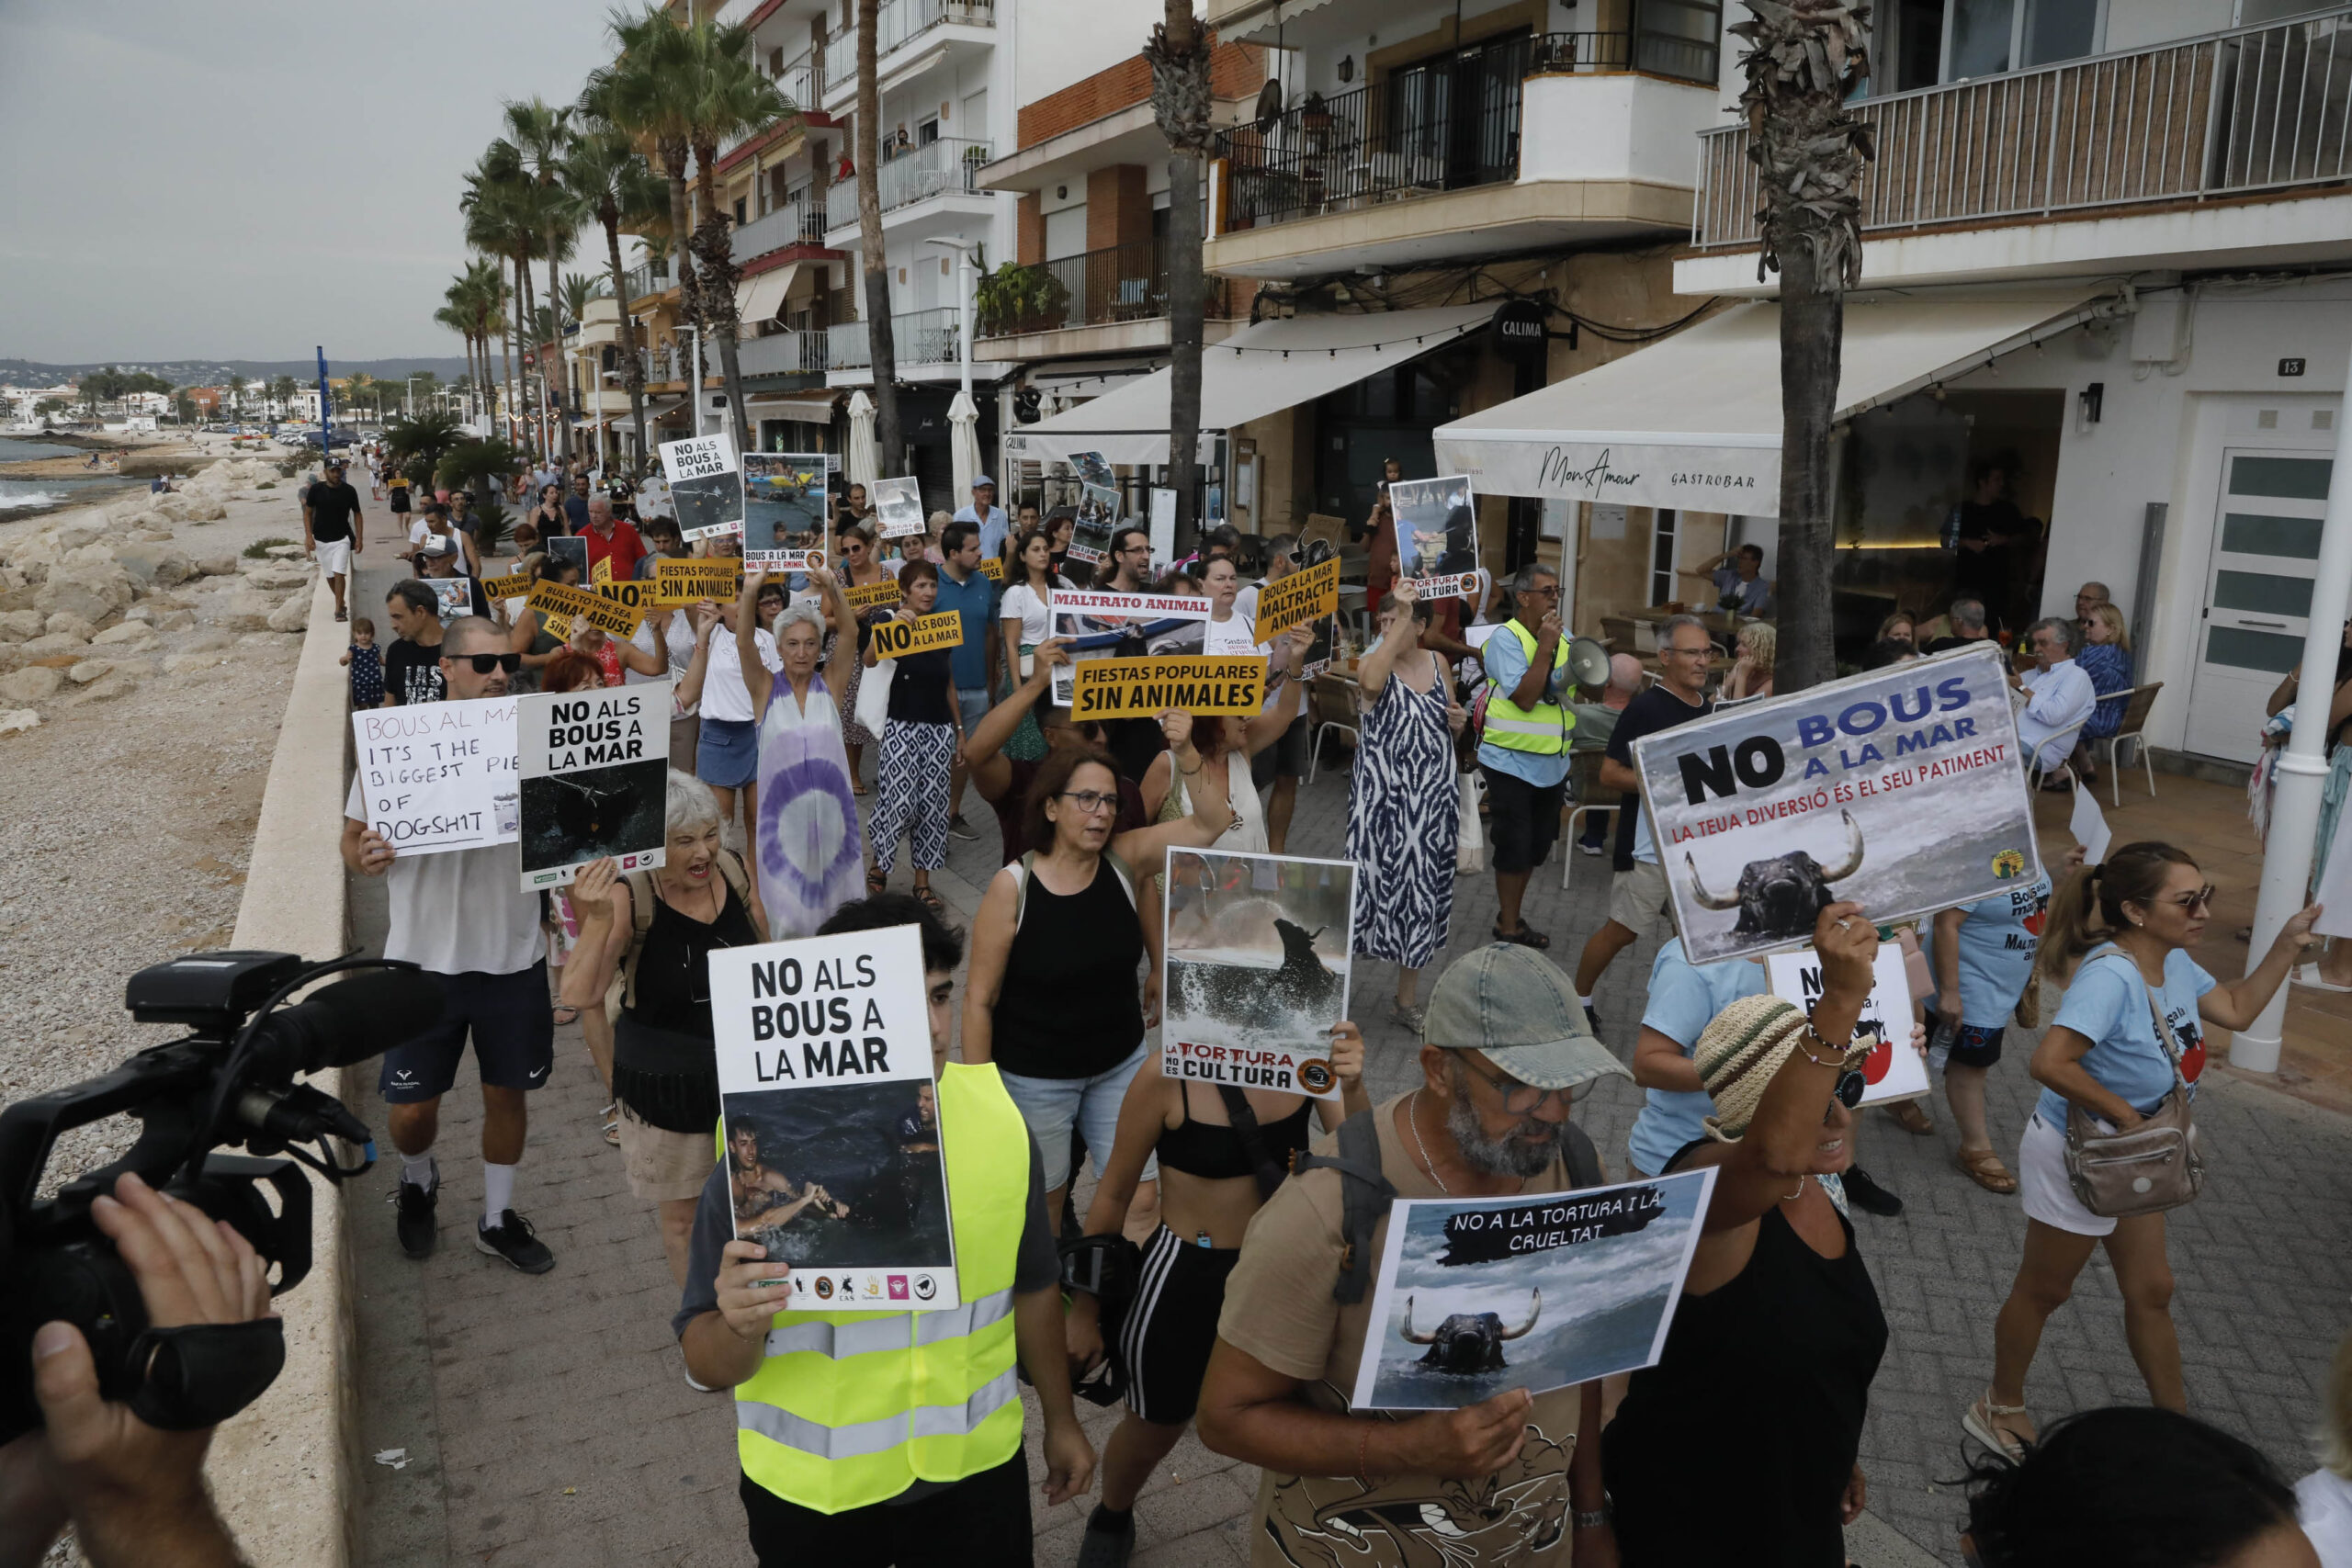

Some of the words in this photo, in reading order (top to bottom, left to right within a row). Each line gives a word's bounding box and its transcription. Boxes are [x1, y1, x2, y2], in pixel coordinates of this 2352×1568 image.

[1502, 321, 1542, 337] CALIMA
[2284, 361, 2299, 373] 13
[674, 444, 693, 456] NO
[696, 441, 717, 452] ALS
[676, 452, 710, 468] BOUS
[713, 452, 721, 461] A
[679, 469, 695, 479] LA
[695, 462, 724, 477] MAR
[1671, 472, 1755, 488] GASTROBAR
[746, 551, 766, 560] BOUS
[769, 551, 775, 559] A
[777, 551, 786, 559] LA
[789, 551, 805, 560] MAR
[746, 560, 782, 570] MALTRCTE
[784, 560, 806, 569] ANIMAL
[497, 578, 511, 588] ALS
[512, 575, 530, 585] BOU
[660, 565, 697, 577] FIESTAS
[699, 566, 734, 578] POPULARES
[1416, 575, 1460, 588] ORTURA
[484, 580, 499, 598] O
[506, 587, 518, 595] LA
[661, 580, 688, 597] SIN
[690, 580, 734, 597] ANIMALES
[1263, 580, 1289, 603] BOUS
[1291, 581, 1298, 592] A
[1300, 574, 1312, 589] LA
[1313, 562, 1333, 581] MAR
[1419, 584, 1459, 599] ULTURA
[545, 586, 577, 602] BULLS
[578, 595, 593, 605] TO
[593, 600, 614, 614] THE
[612, 606, 632, 620] SEA
[601, 584, 640, 607] NO
[641, 599, 649, 607] A
[848, 595, 873, 607] IMAL
[874, 589, 901, 604] ABUSE
[1054, 593, 1142, 609] MALTRATO
[1145, 598, 1210, 613] ANIMAL
[1260, 577, 1335, 622] MALTRACTE
[548, 619, 567, 635] SIN
[586, 611, 635, 637] ABUSE
[910, 621, 929, 634] ALS
[930, 615, 957, 629] BOUS
[1270, 600, 1323, 634] ANIMAL
[875, 624, 912, 655] NO
[913, 636, 921, 647] A
[922, 634, 935, 645] LA
[936, 628, 959, 643] MAR
[1082, 666, 1150, 683] FIESTAS
[1155, 665, 1259, 680] POPULARES
[1080, 686, 1124, 712] SIN
[1128, 683, 1255, 708] ANIMALES
[551, 701, 590, 725] NO
[597, 696, 640, 720] ALS
[366, 716, 431, 741] BOUS
[440, 711, 471, 731] AL
[485, 705, 518, 725] MA
[549, 720, 621, 749] BOUS
[628, 719, 642, 738] A
[1677, 735, 1785, 806] NO
[1796, 677, 1972, 750] BOUS
[369, 746, 412, 766] IT'S
[430, 739, 480, 761] THE
[549, 752, 578, 771] LA
[584, 739, 643, 766] MAR
[1804, 758, 1829, 780] A
[1840, 745, 1883, 770] LA
[1895, 716, 1978, 757] MAR
[370, 762, 464, 787] BIGGEST
[487, 755, 518, 773] PIE
[379, 795, 412, 812] OF
[1672, 827, 1694, 844] LA
[1698, 815, 1742, 839] TEUA
[1746, 785, 1829, 827] DIVERSIÓ
[1834, 780, 1854, 804] ÉS
[1859, 779, 1879, 797] EL
[1883, 769, 1914, 791] SEU
[1918, 744, 2006, 783] PATIMENT
[752, 958, 804, 999] NO
[813, 954, 876, 993] ALS
[752, 997, 853, 1042] BOUS
[863, 998, 885, 1032] A
[755, 1049, 797, 1082] LA
[802, 1036, 890, 1079] MAR
[1166, 1044, 1178, 1055] LA
[1178, 1042, 1295, 1068] TORTURA
[1166, 1066, 1178, 1076] ES
[1166, 1056, 1179, 1066] NO
[1182, 1060, 1292, 1089] CULTURA
[1454, 1214, 1484, 1231] NO
[1489, 1213, 1504, 1229] A
[1510, 1211, 1534, 1228] LA
[1542, 1200, 1623, 1225] TORTURA
[1627, 1197, 1638, 1213] I
[1639, 1193, 1661, 1211] LA
[1510, 1224, 1604, 1250] CRUELTAT
